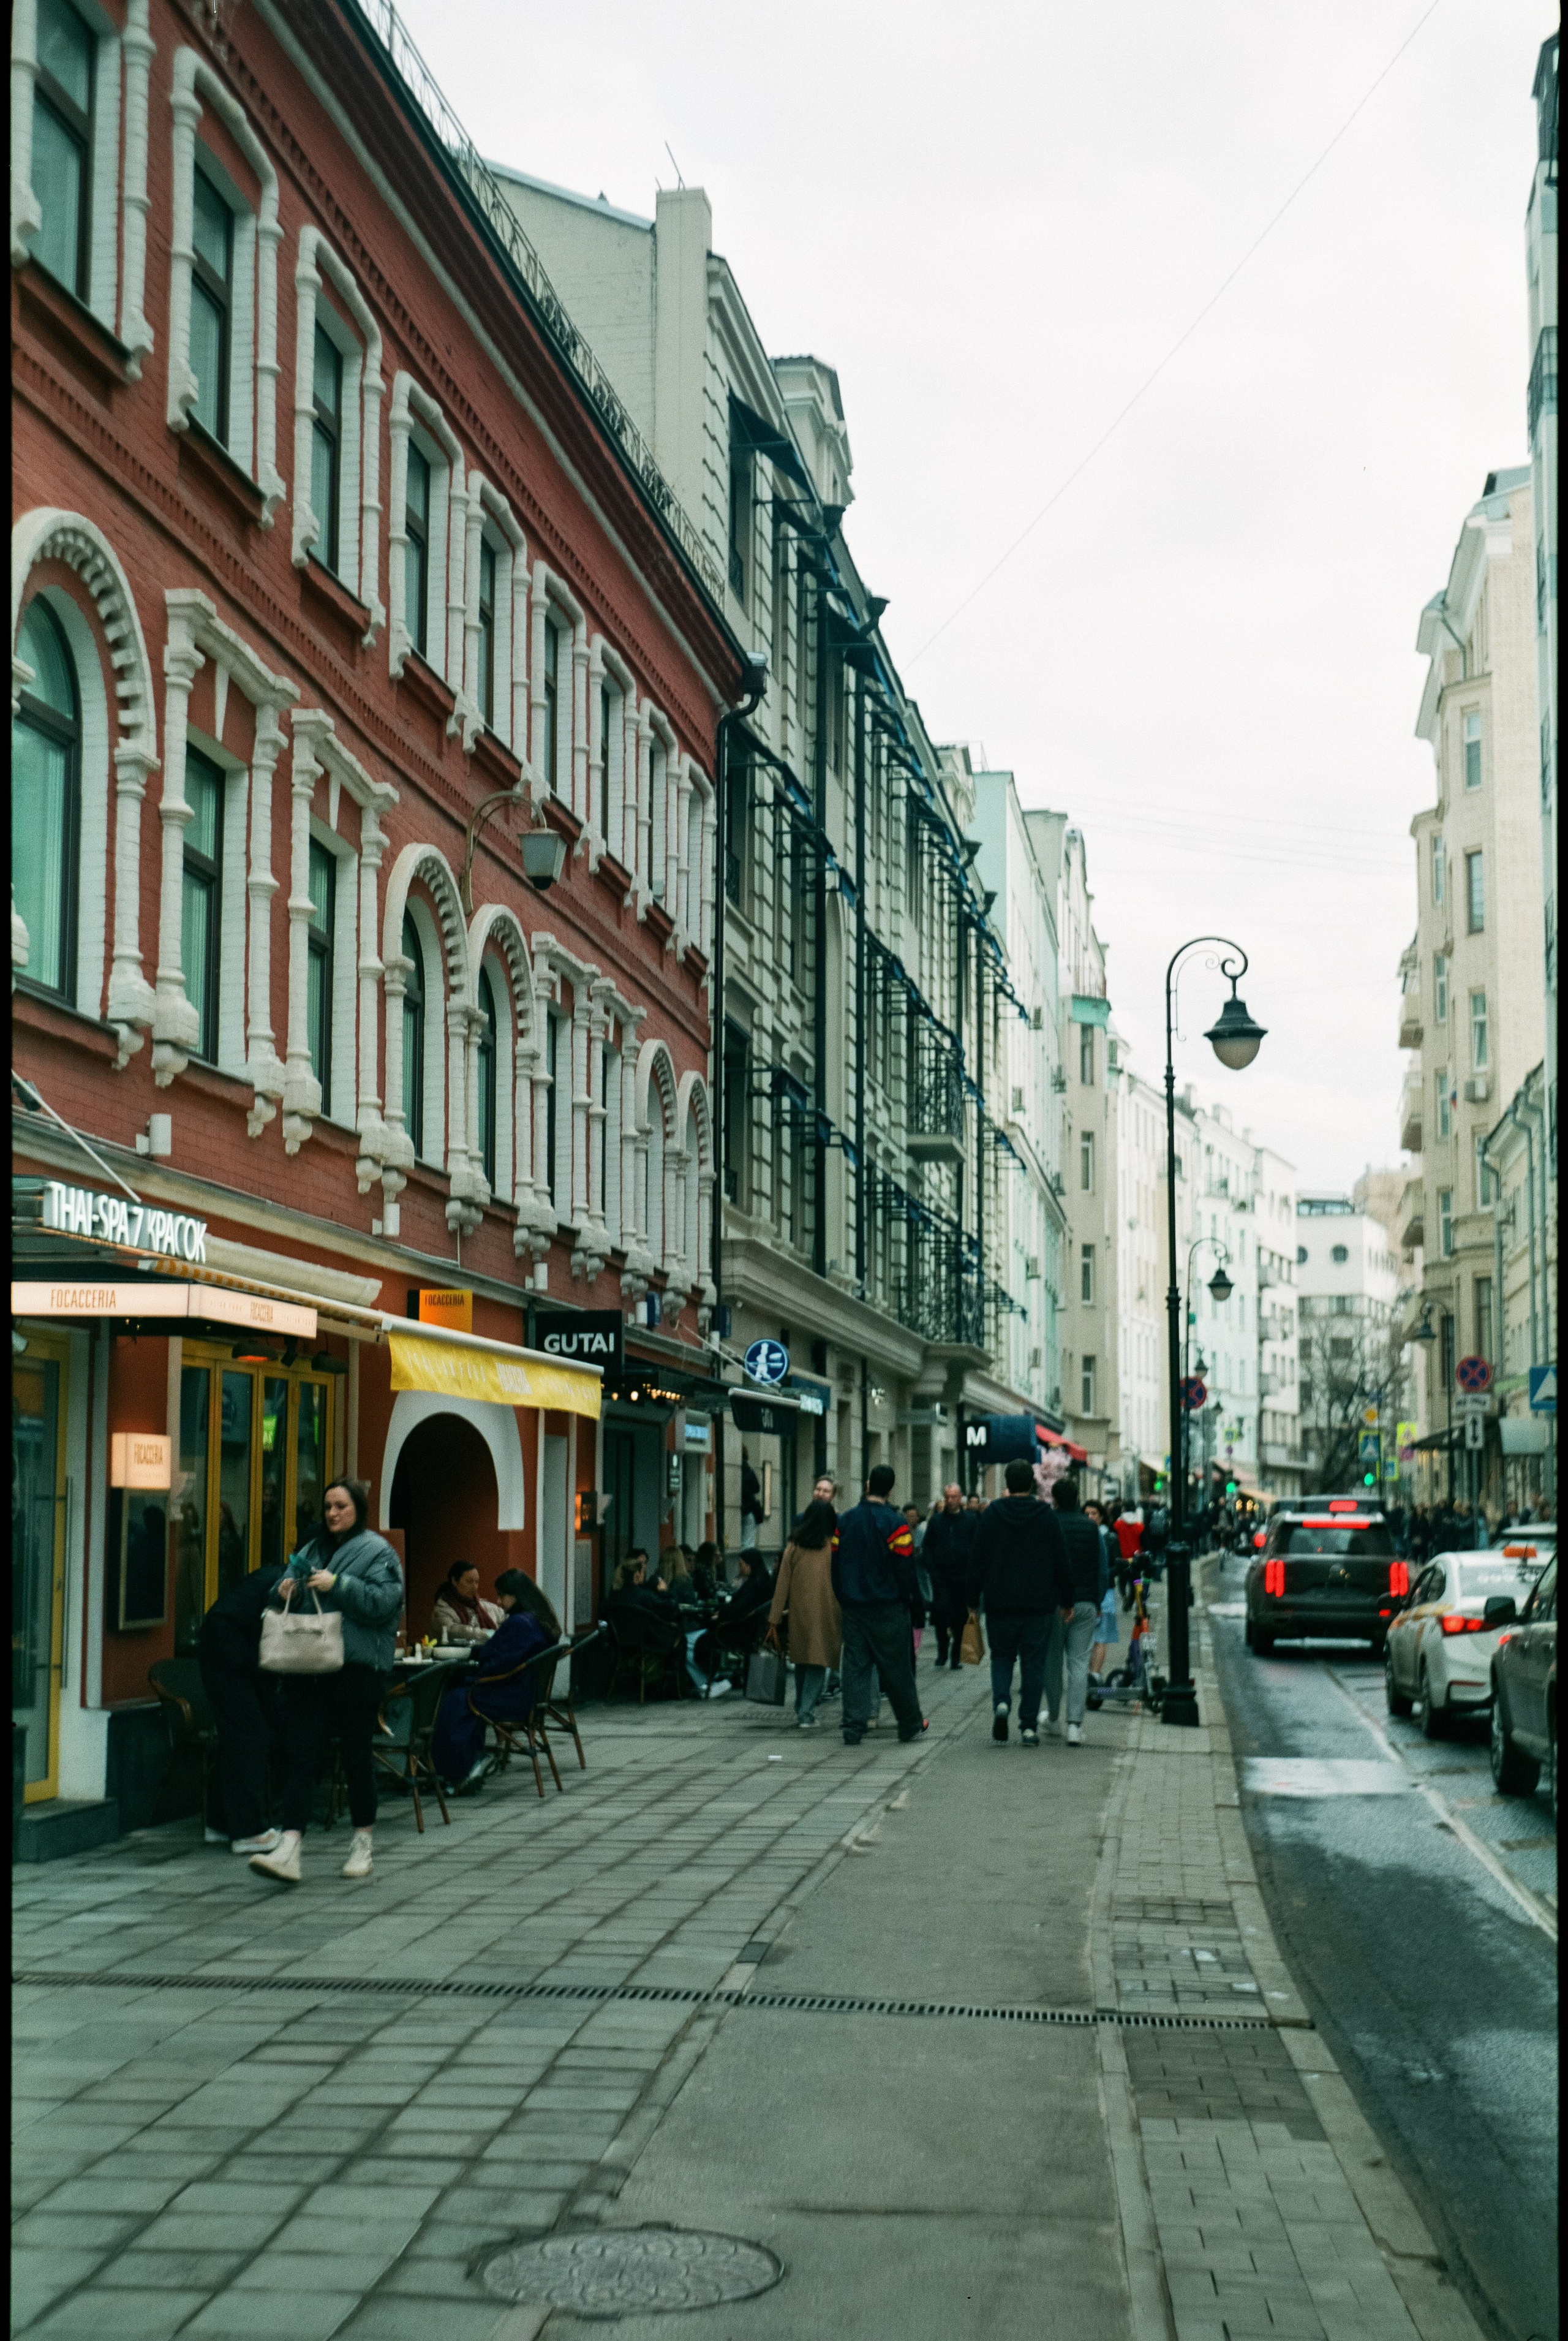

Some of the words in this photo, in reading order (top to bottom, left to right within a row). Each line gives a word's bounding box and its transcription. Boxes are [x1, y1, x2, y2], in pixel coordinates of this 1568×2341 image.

[49, 1181, 129, 1246] THAI-SPA
[131, 1206, 144, 1247] 7
[146, 1209, 208, 1264] КРАСОК
[51, 1289, 116, 1308] FOCACCERIA
[424, 1294, 464, 1306] FOCACCERIA
[544, 1333, 614, 1353] GUTAI
[967, 1426, 987, 1446] M
